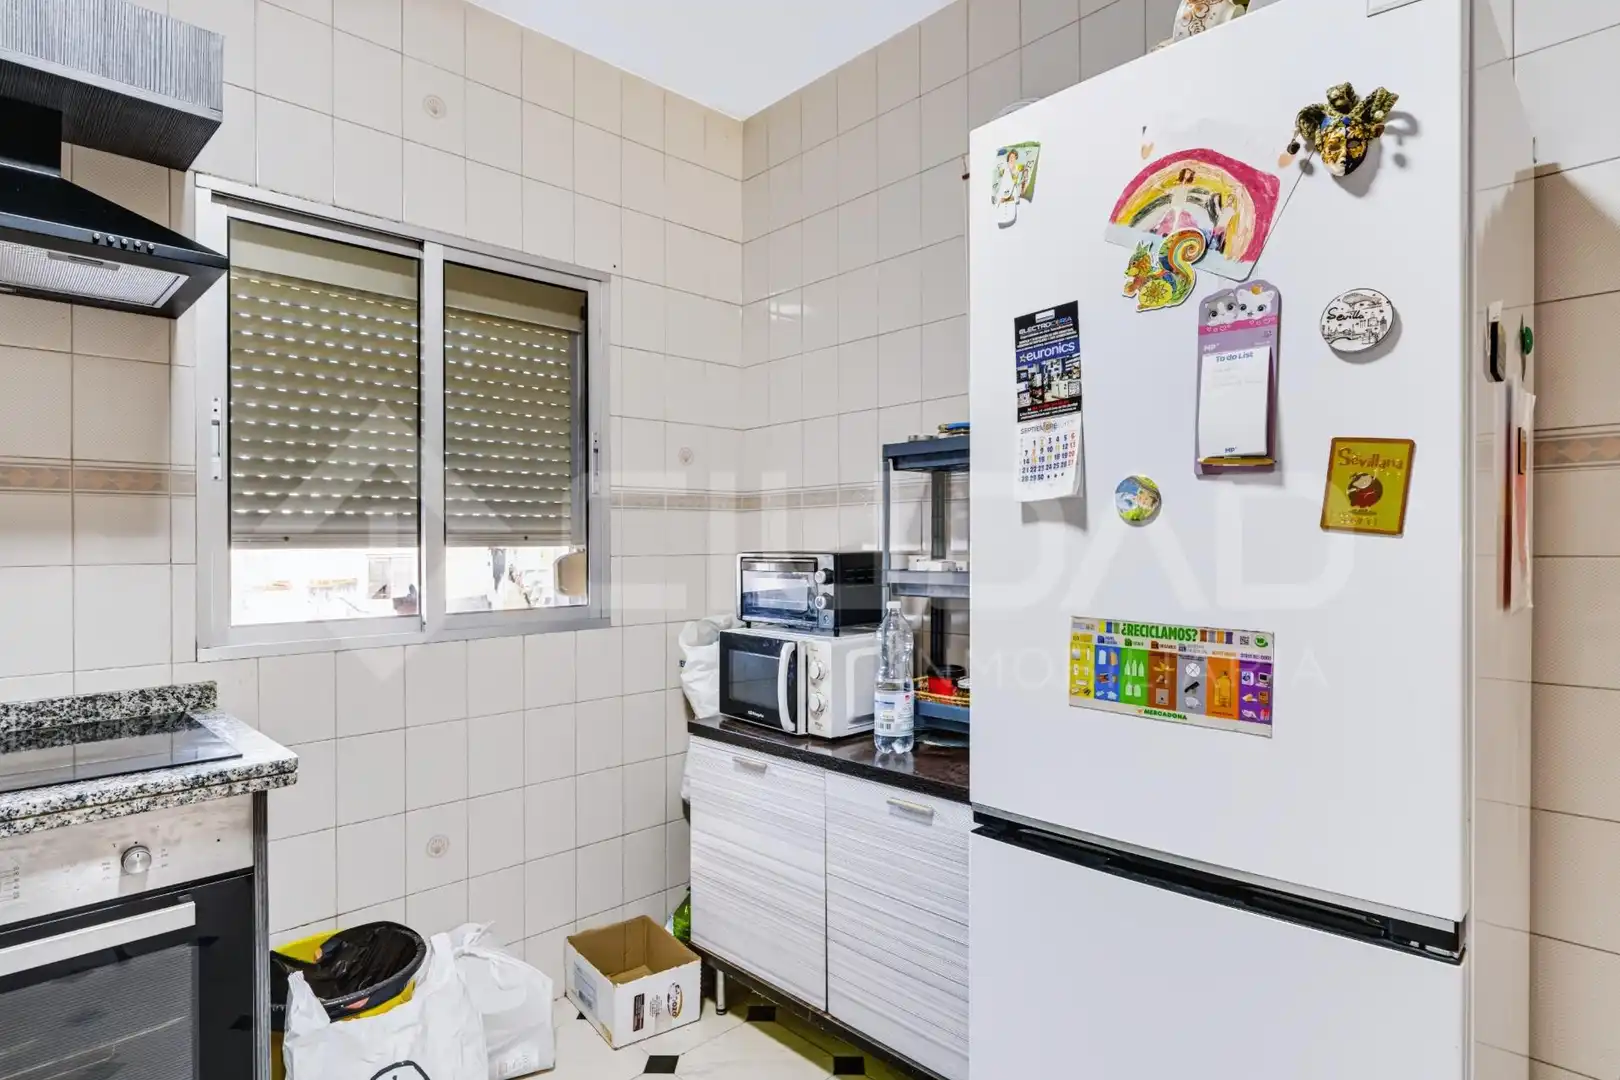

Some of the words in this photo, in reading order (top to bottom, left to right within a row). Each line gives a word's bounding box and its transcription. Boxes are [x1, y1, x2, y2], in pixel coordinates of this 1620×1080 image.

[1326, 306, 1364, 321] Sevilla
[1026, 341, 1076, 361] euronics
[1226, 353, 1238, 361] do
[1238, 351, 1254, 360] List
[1337, 447, 1404, 470] Sevillana
[1045, 463, 1053, 471] 24
[1053, 462, 1060, 470] 25
[1120, 623, 1198, 642] ¿RECICLAMOS?
[1143, 708, 1188, 720] MERCADONA
